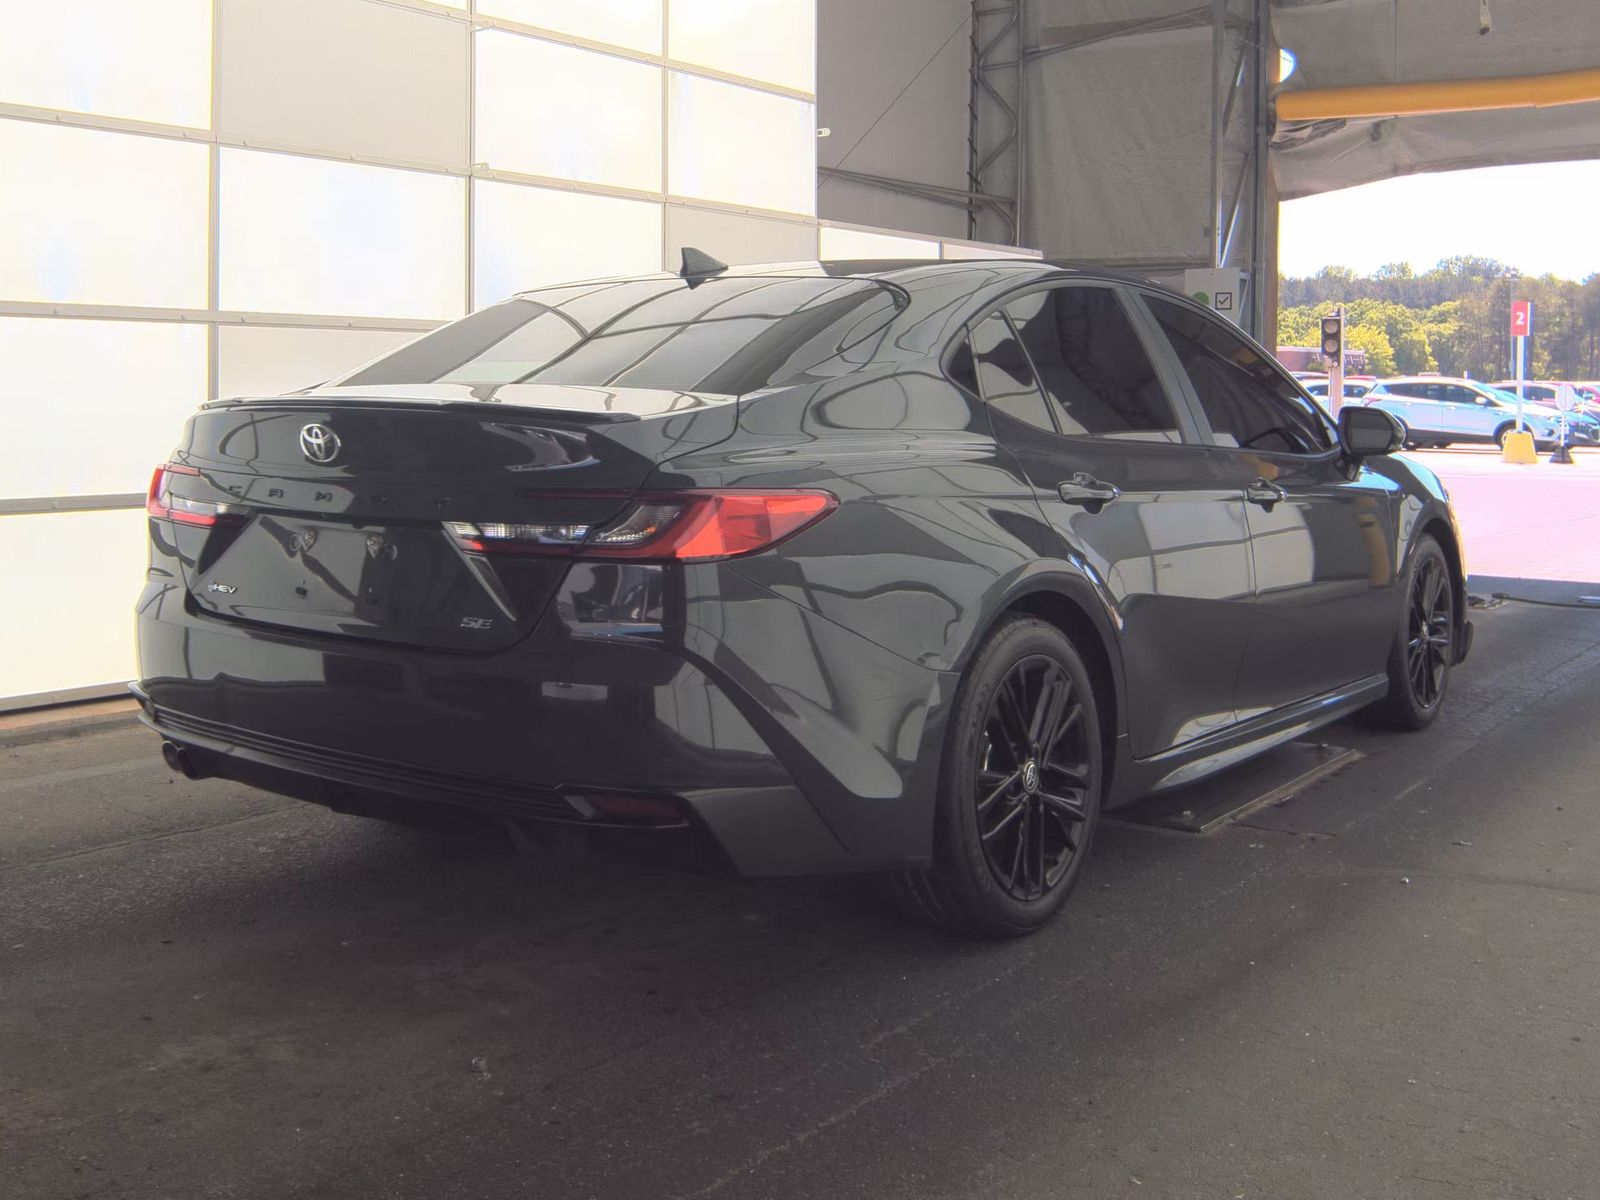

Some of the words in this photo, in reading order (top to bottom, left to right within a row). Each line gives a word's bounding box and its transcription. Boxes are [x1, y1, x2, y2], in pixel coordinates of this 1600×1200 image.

[1515, 311, 1525, 325] 2
[213, 583, 236, 594] HEV
[460, 617, 493, 629] SE
